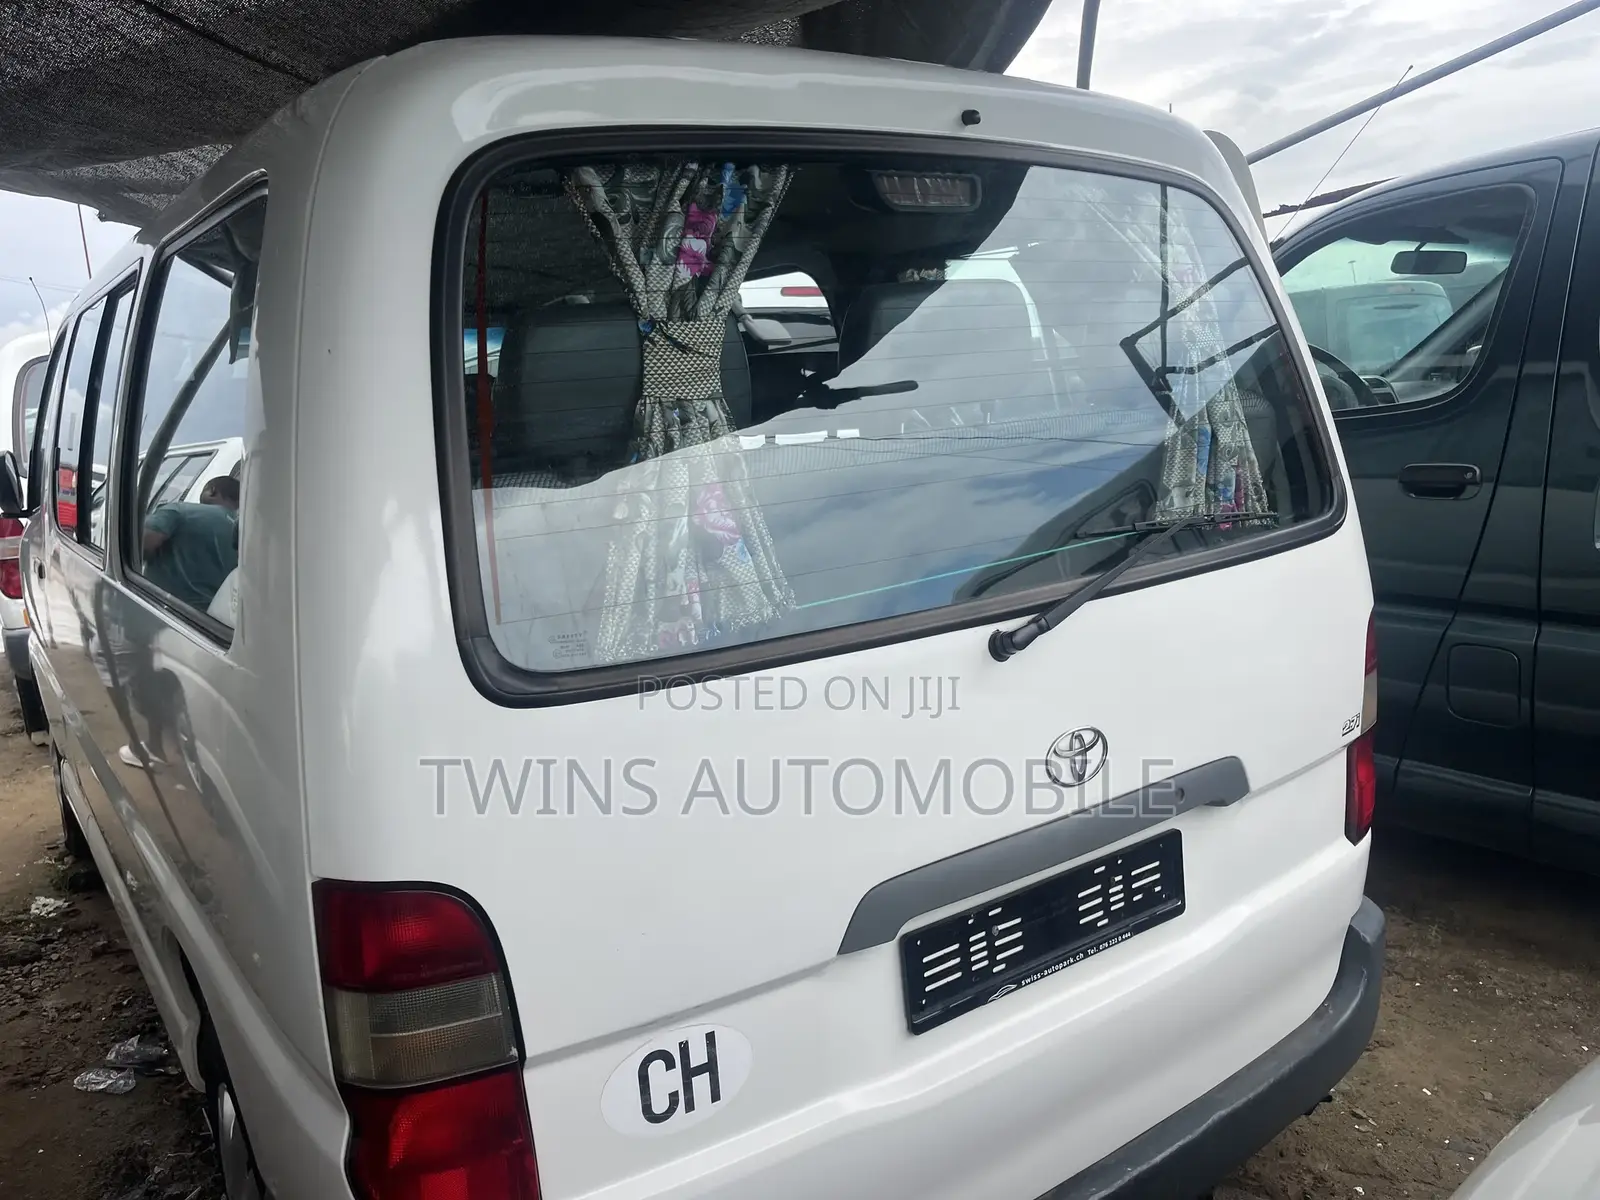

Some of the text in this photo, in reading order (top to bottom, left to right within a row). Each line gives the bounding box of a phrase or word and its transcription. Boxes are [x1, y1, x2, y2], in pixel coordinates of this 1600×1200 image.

[1021, 952, 1084, 986] swiss-autopark.ch
[1087, 946, 1098, 955] Tel.
[637, 1030, 721, 1124] CH
